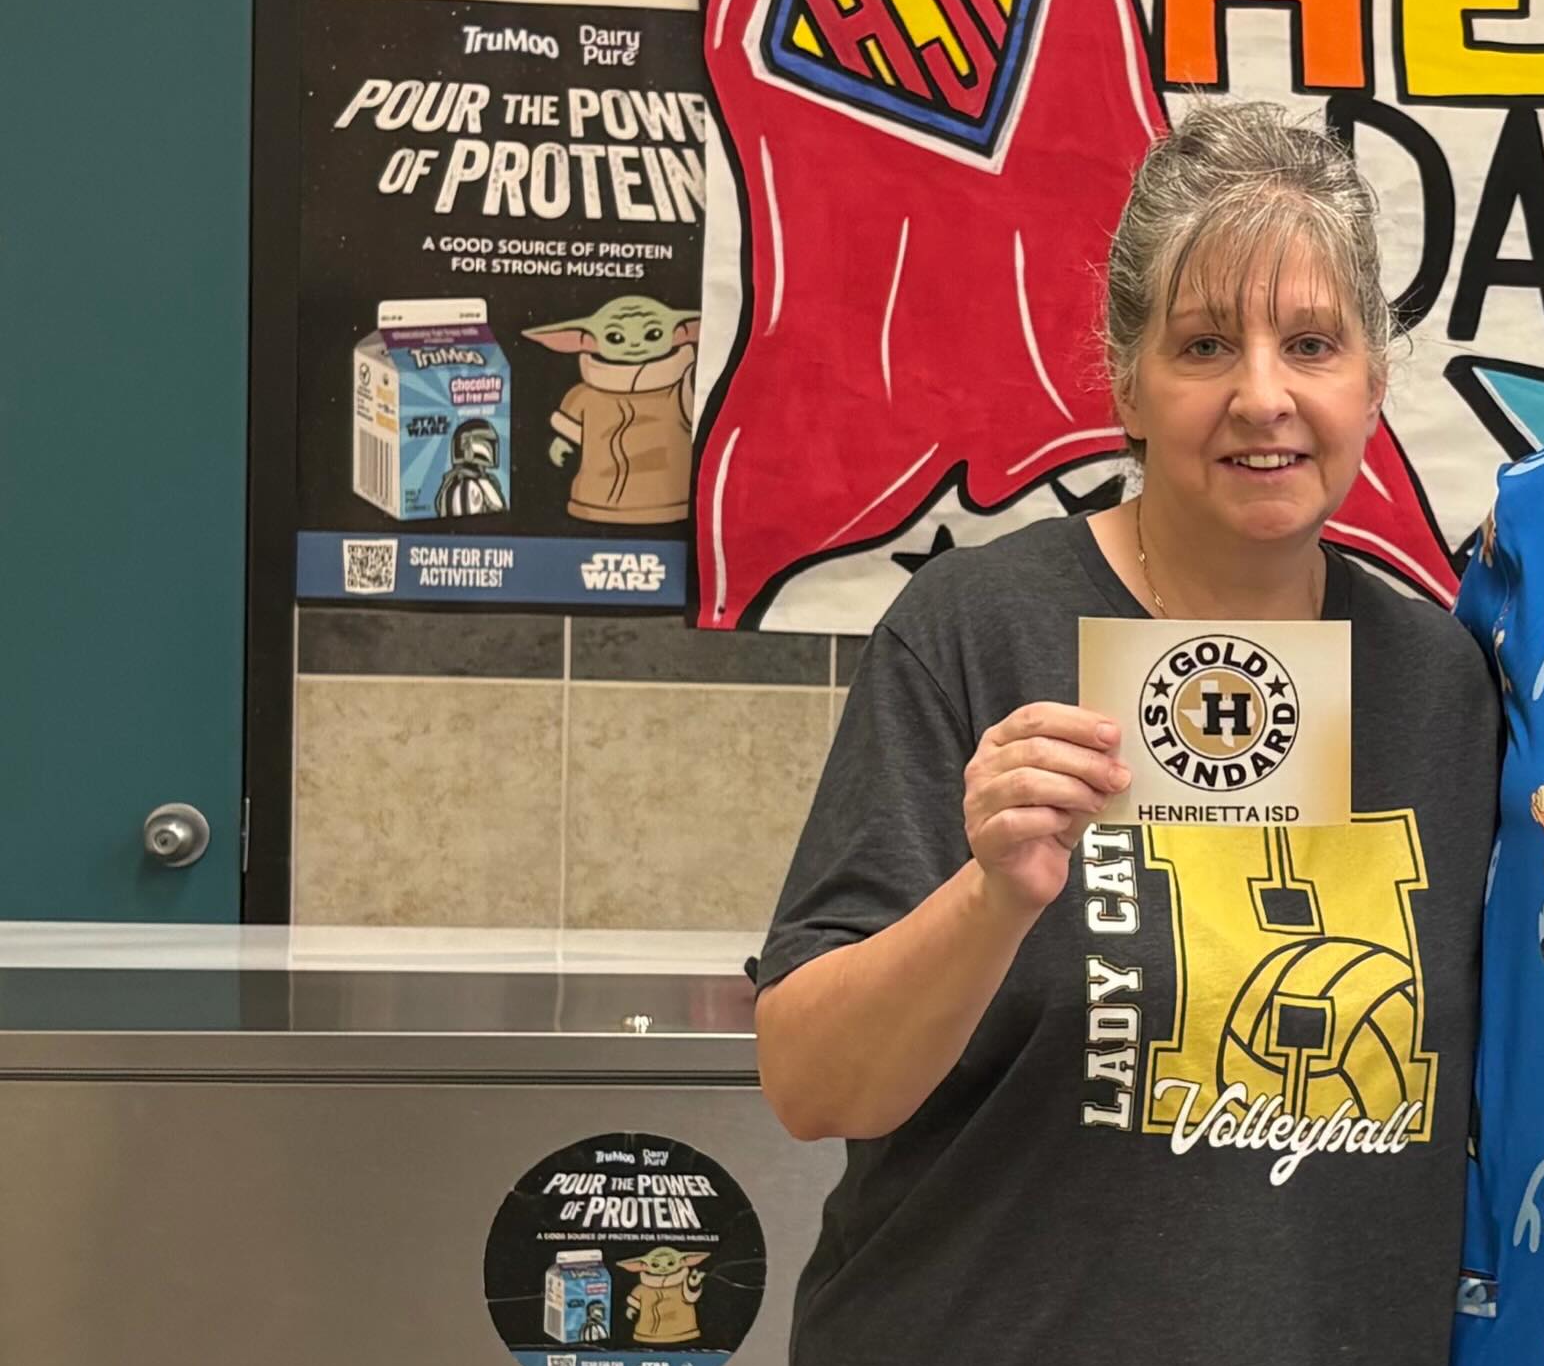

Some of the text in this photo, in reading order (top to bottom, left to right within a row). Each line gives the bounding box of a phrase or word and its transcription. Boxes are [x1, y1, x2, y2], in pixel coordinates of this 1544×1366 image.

[463, 25, 560, 59] TruMoo
[579, 25, 641, 51] Dairy
[583, 45, 637, 66] Pure
[334, 78, 490, 133] POUR
[502, 93, 560, 126] THE
[378, 138, 706, 224] OF PROTEIN
[422, 236, 673, 260] A GOOD SOURCE OF PROTEIN
[451, 257, 645, 279] FOR STRONG MUSCLES
[411, 348, 485, 368] TruMoo
[410, 547, 514, 568] SCAN FOR FUN
[581, 553, 665, 572] STAR
[420, 567, 504, 587] ACTIVITIES!
[583, 570, 665, 591] WARS
[1169, 642, 1268, 678] GOLD
[1202, 693, 1252, 736] H
[1144, 702, 1296, 788] STANDARD
[1138, 804, 1300, 822] HENRIETTA ISD
[1083, 822, 1143, 1133] LADY CAT
[1153, 1077, 1424, 1186] Volleyball
[542, 1173, 720, 1197] POUR THE POWER
[559, 1196, 702, 1229] OF PROTEIN
